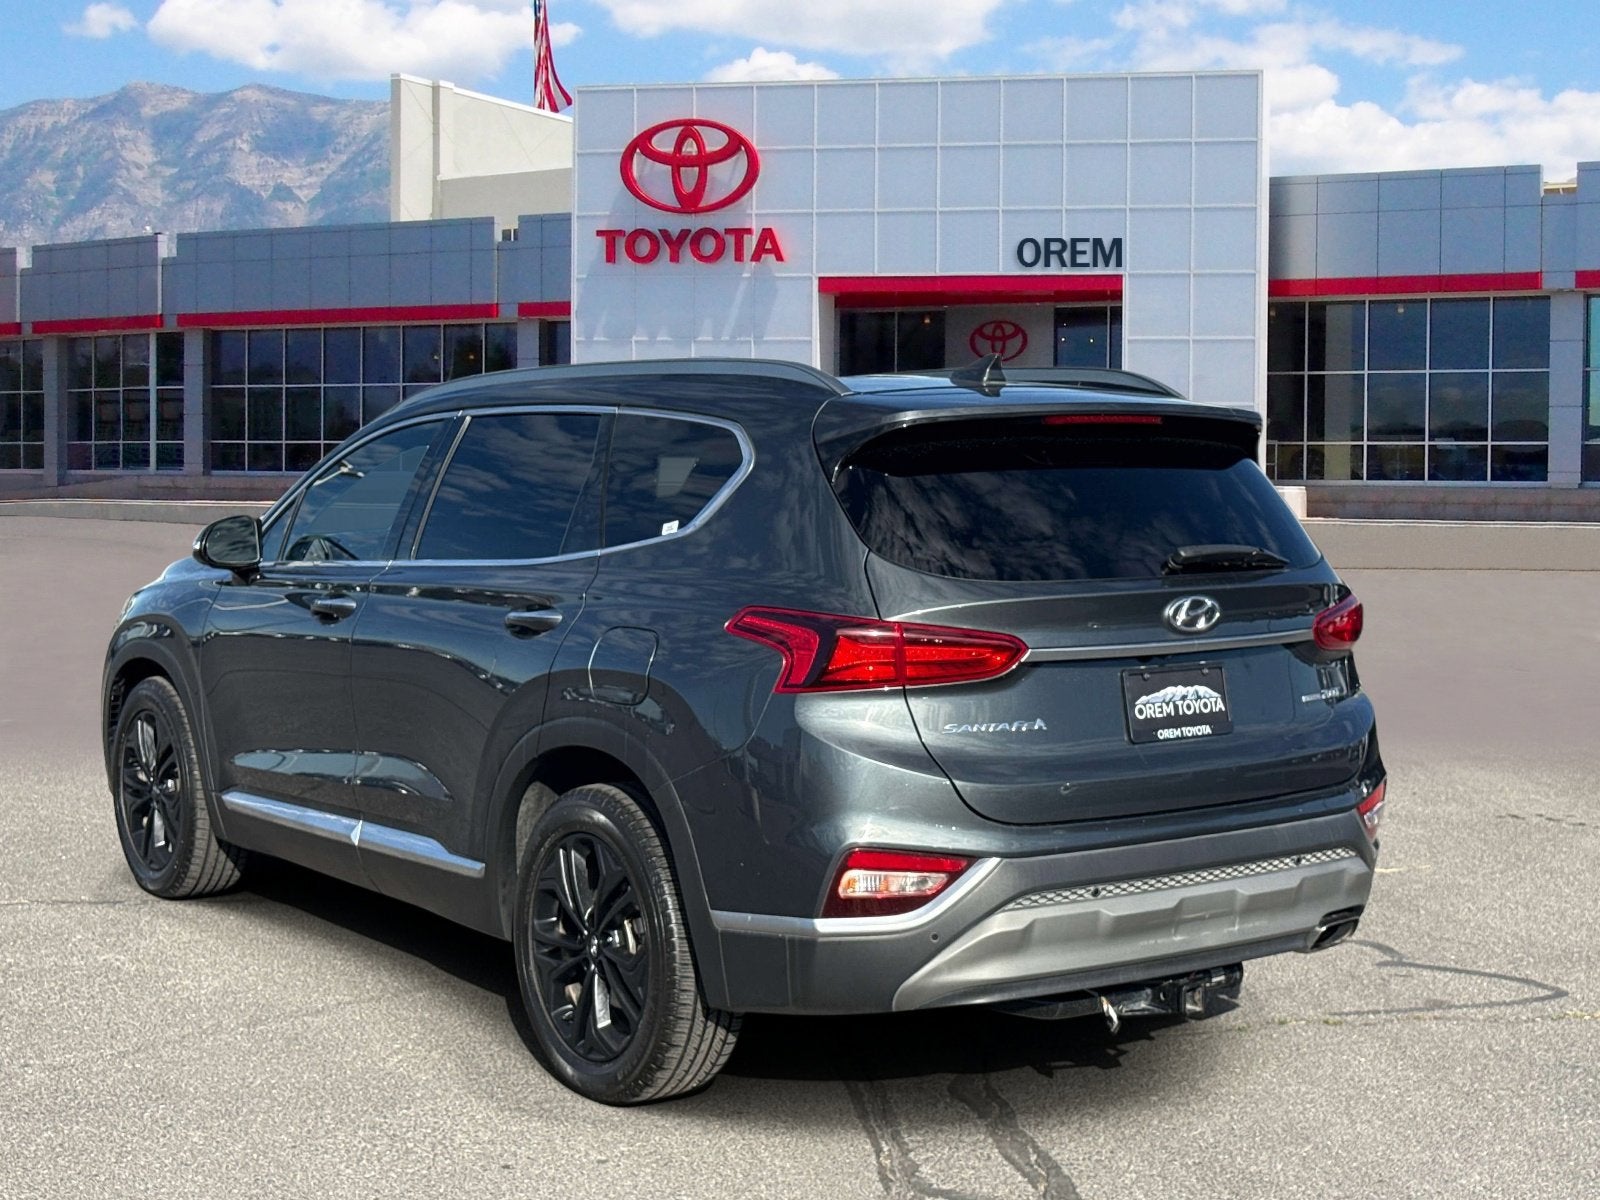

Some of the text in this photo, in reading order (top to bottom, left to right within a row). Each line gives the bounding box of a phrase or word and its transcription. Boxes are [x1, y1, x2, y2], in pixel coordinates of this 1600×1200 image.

[596, 227, 785, 264] TOYOTA
[1017, 237, 1122, 268] OREM
[1134, 697, 1226, 720] OREM TOYOTA
[1157, 724, 1213, 740] OREM TOYOTA
